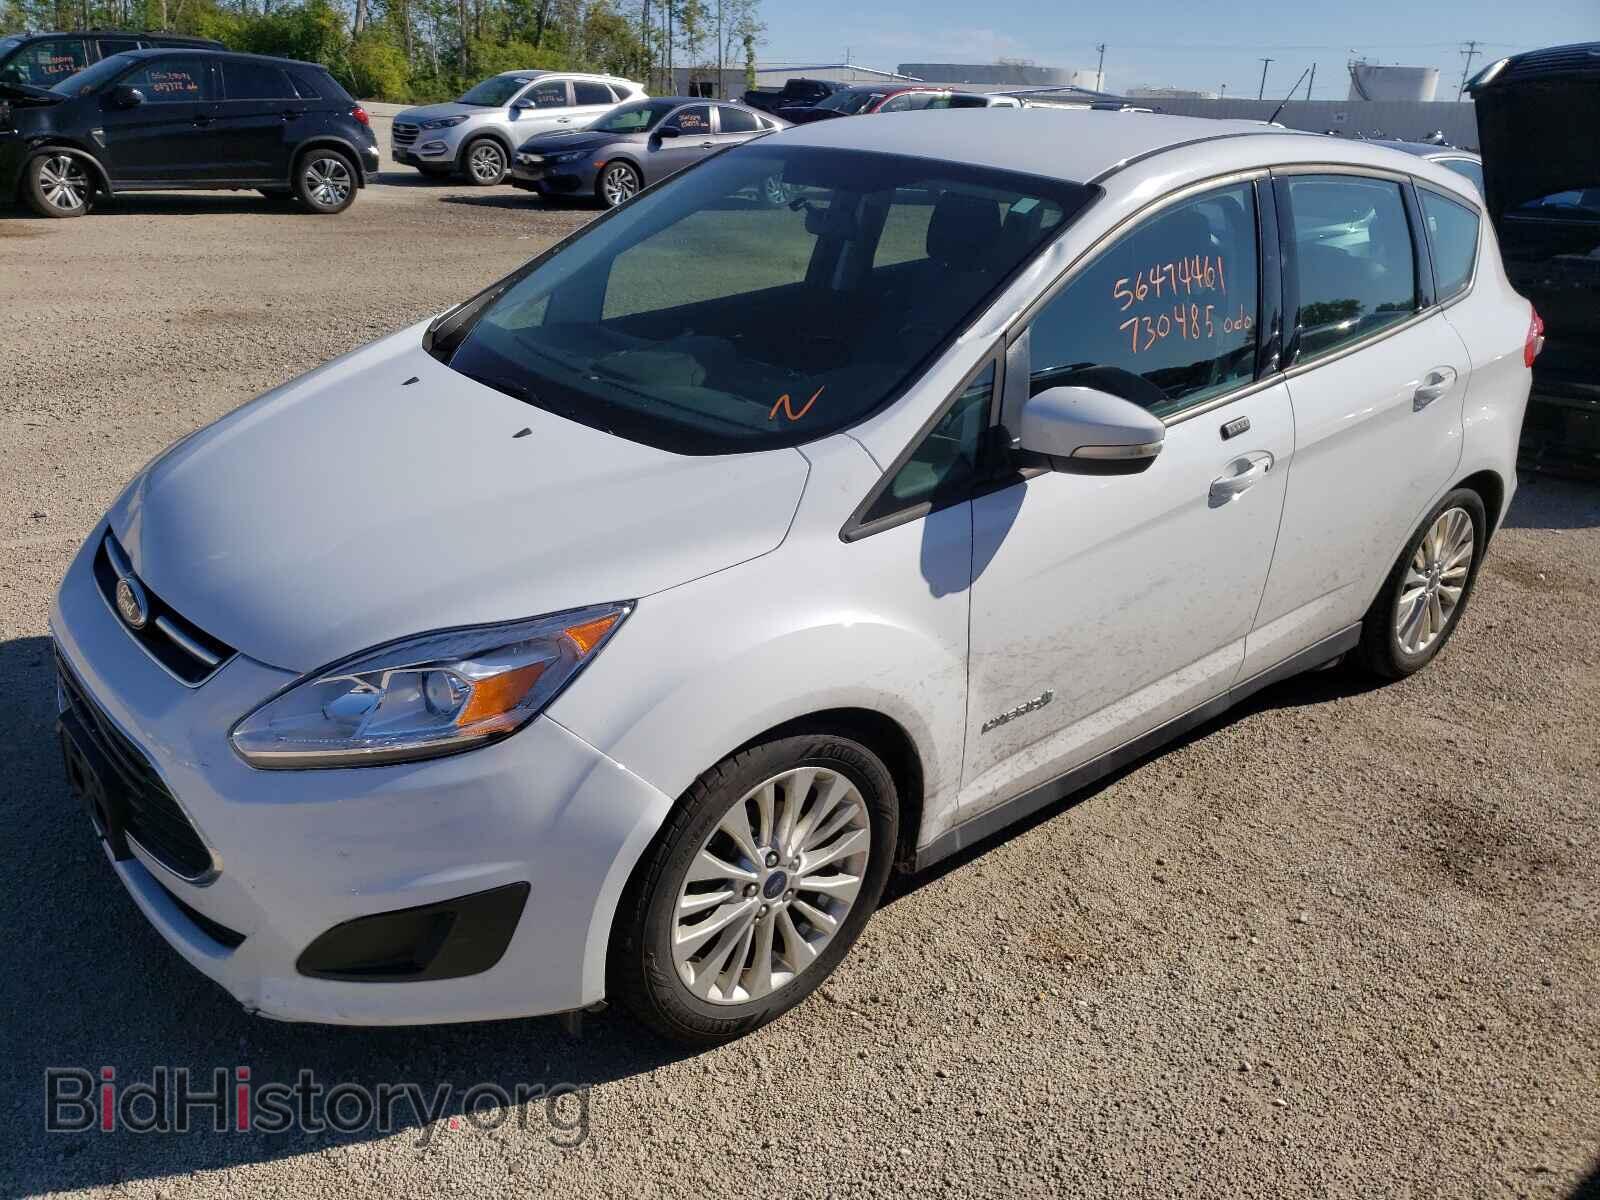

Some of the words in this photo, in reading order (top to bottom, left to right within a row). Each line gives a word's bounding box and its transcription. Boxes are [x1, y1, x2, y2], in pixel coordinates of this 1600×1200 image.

[1113, 255, 1226, 311] 56474461
[1119, 303, 1216, 353] 730485
[1223, 304, 1252, 334] odo
